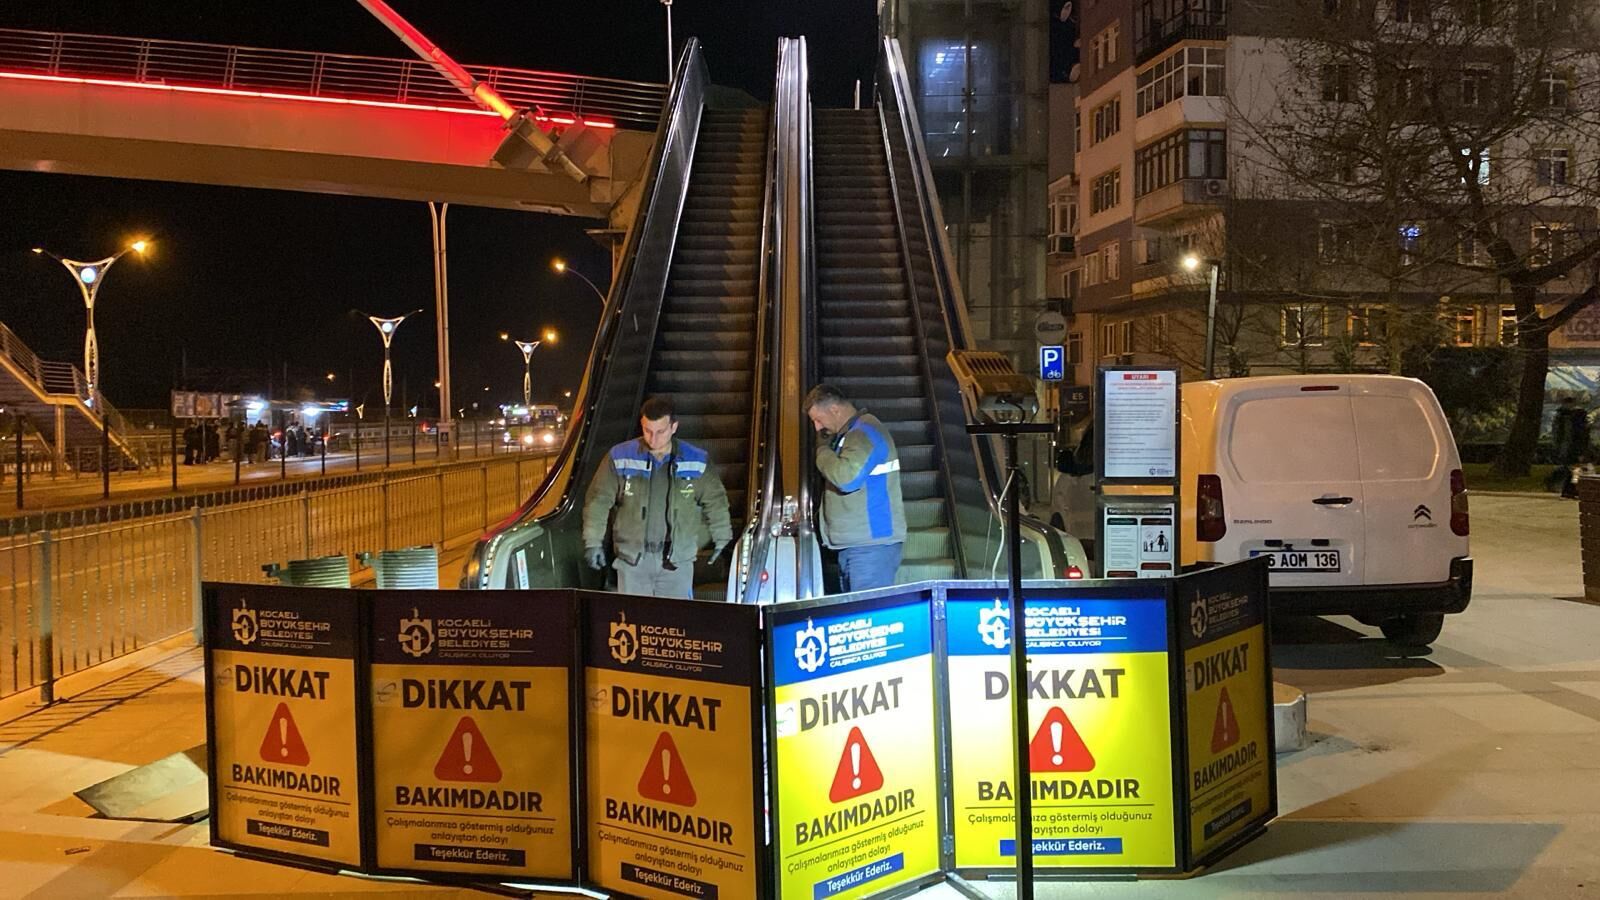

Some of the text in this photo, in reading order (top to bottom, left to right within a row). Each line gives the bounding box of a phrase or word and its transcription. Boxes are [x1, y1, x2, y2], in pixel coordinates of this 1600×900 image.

[1044, 349, 1059, 368] P
[1280, 553, 1308, 567] AOM
[1314, 553, 1337, 567] 136
[984, 668, 1125, 700] DKKAT
[1194, 740, 1257, 791] BAKIMDADIR
[232, 763, 340, 796] BAKIMDADIR
[978, 779, 1140, 801] BAIMDADIR
[395, 786, 543, 812] BAKIMDADIR
[606, 798, 733, 845] BAKIMDADIR
[795, 788, 915, 846] BAKIMDADIR
[1050, 813, 1098, 824] göstermiş
[1101, 811, 1152, 823] olduğunuz
[1072, 824, 1103, 834] dolayı
[430, 847, 474, 860] Teşekkür
[788, 820, 924, 875] Çalışmalarımıza göstermiş olduğunuz
[827, 844, 891, 872] anlayıştan dolayı
[1069, 840, 1105, 851] Ederiz.
[635, 852, 702, 876] anlayıştan dolayı
[659, 846, 698, 863] göstermiş
[700, 855, 743, 872] olduğunuz
[634, 867, 704, 895] Teşekkür Ederiz.
[827, 861, 892, 893] Teşekkür Ederiz.
